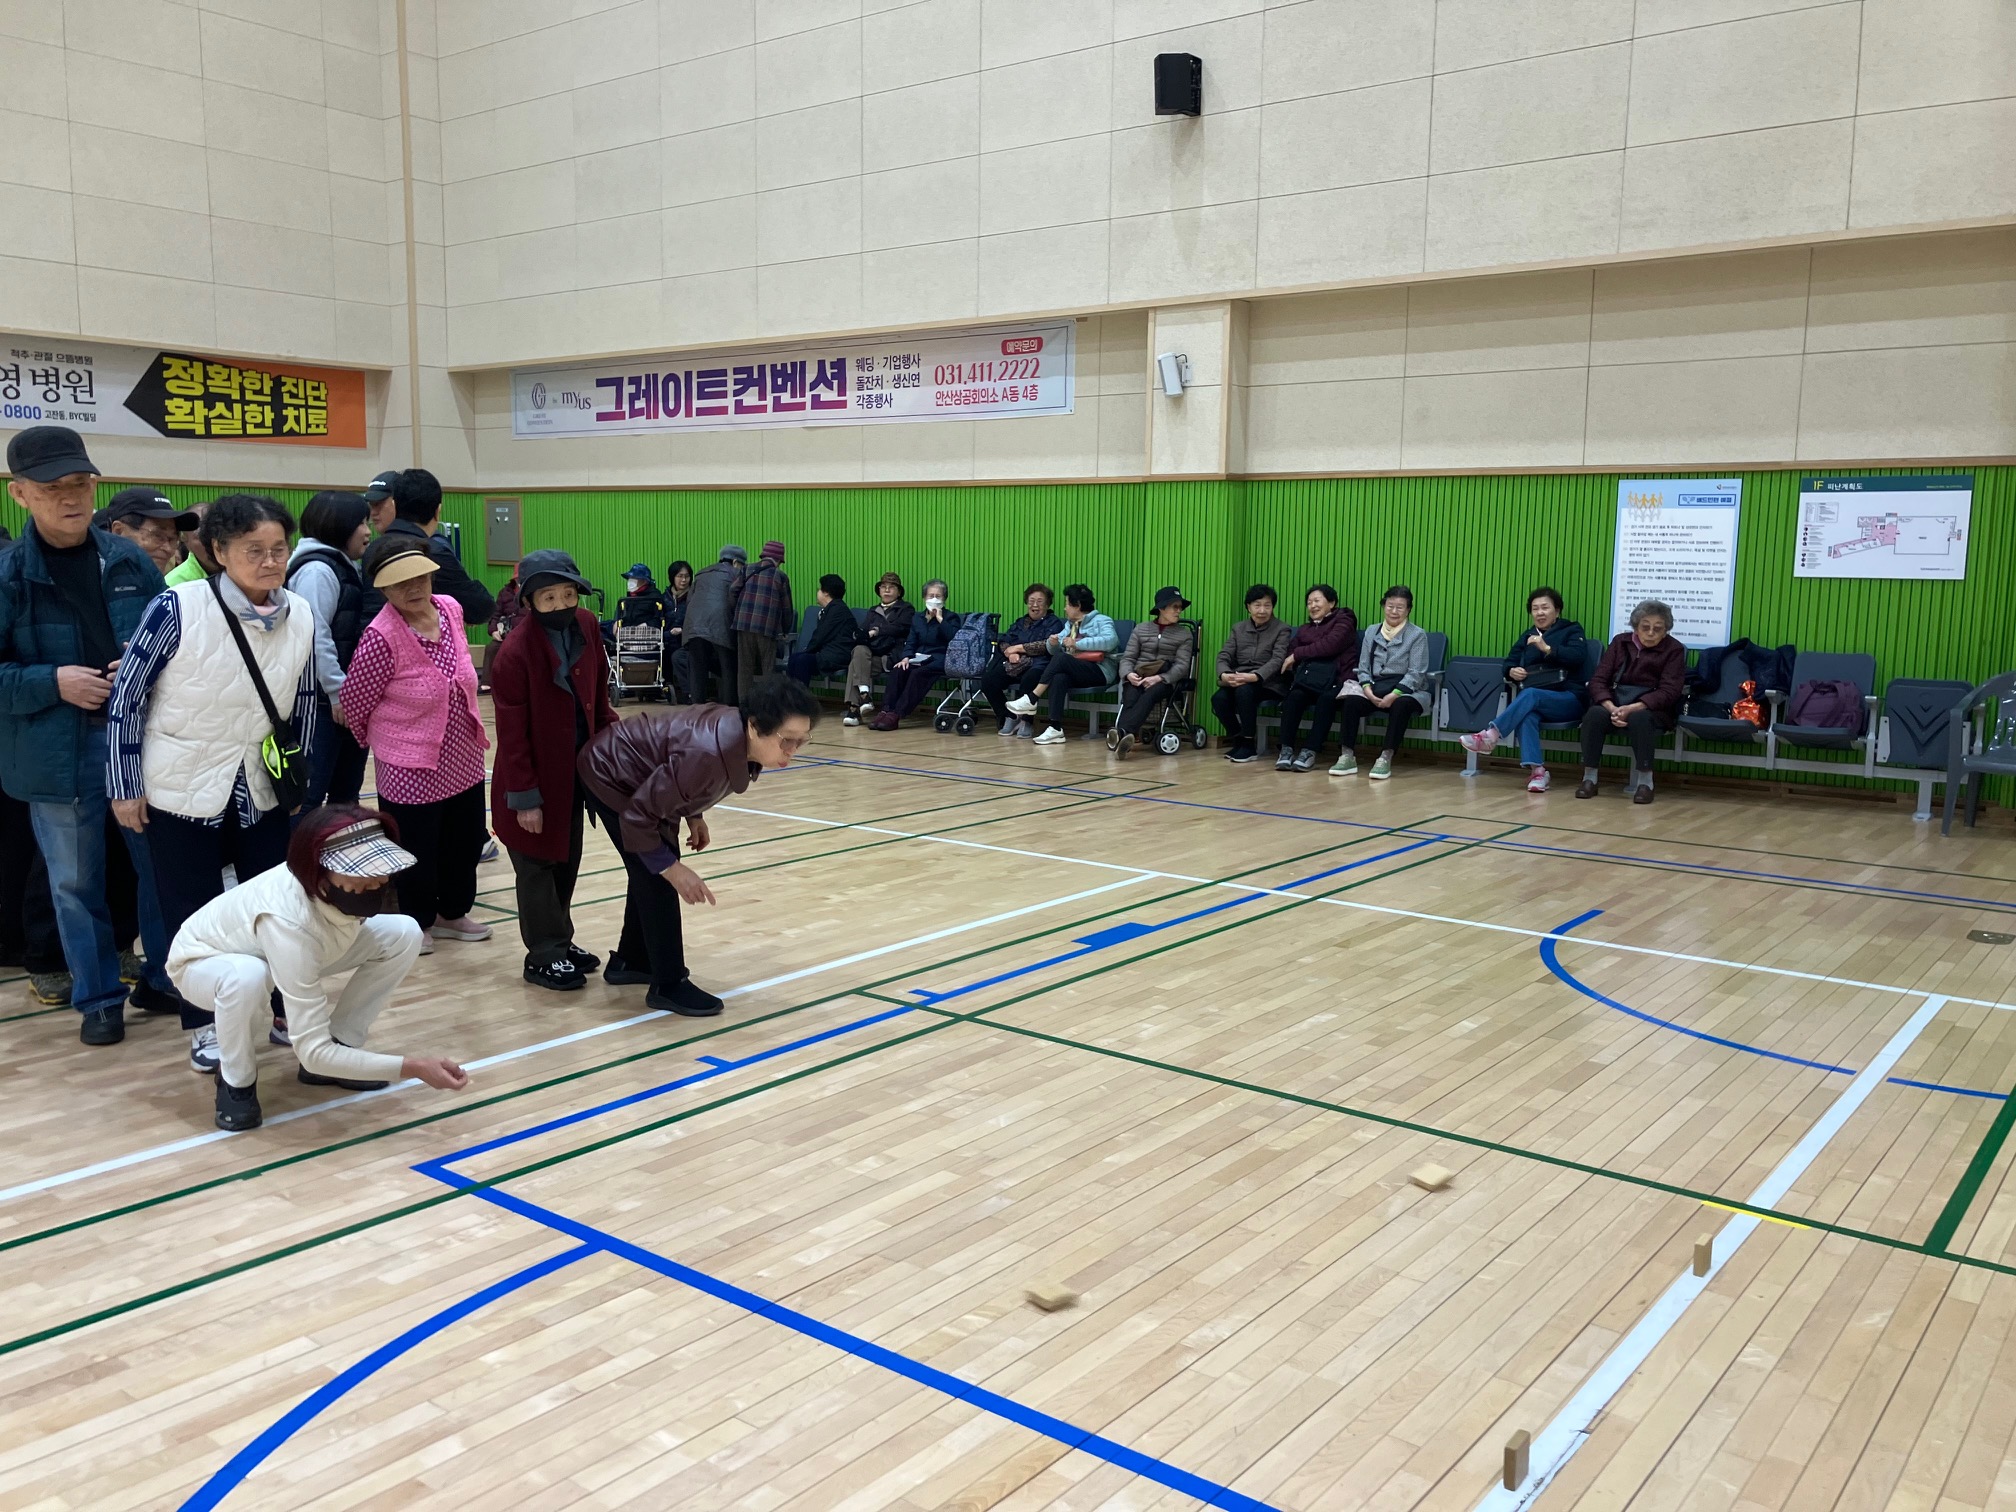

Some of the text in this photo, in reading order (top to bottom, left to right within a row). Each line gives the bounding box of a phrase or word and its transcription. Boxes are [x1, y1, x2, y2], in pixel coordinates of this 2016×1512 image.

[1006, 339, 1038, 353] 예약문의
[855, 352, 921, 373] 웨딩 기업행사
[934, 357, 1041, 386] 031.411.2222
[28, 366, 97, 405] 병원
[162, 356, 328, 407] 정확한 진단
[595, 357, 848, 422] 그레이트컨벤션
[856, 371, 921, 391] 돌잔치 생신연
[856, 392, 893, 410] 각종행사
[935, 383, 1039, 407] 안산상공회의소 A동 4층
[164, 397, 328, 436] 확실한 치료
